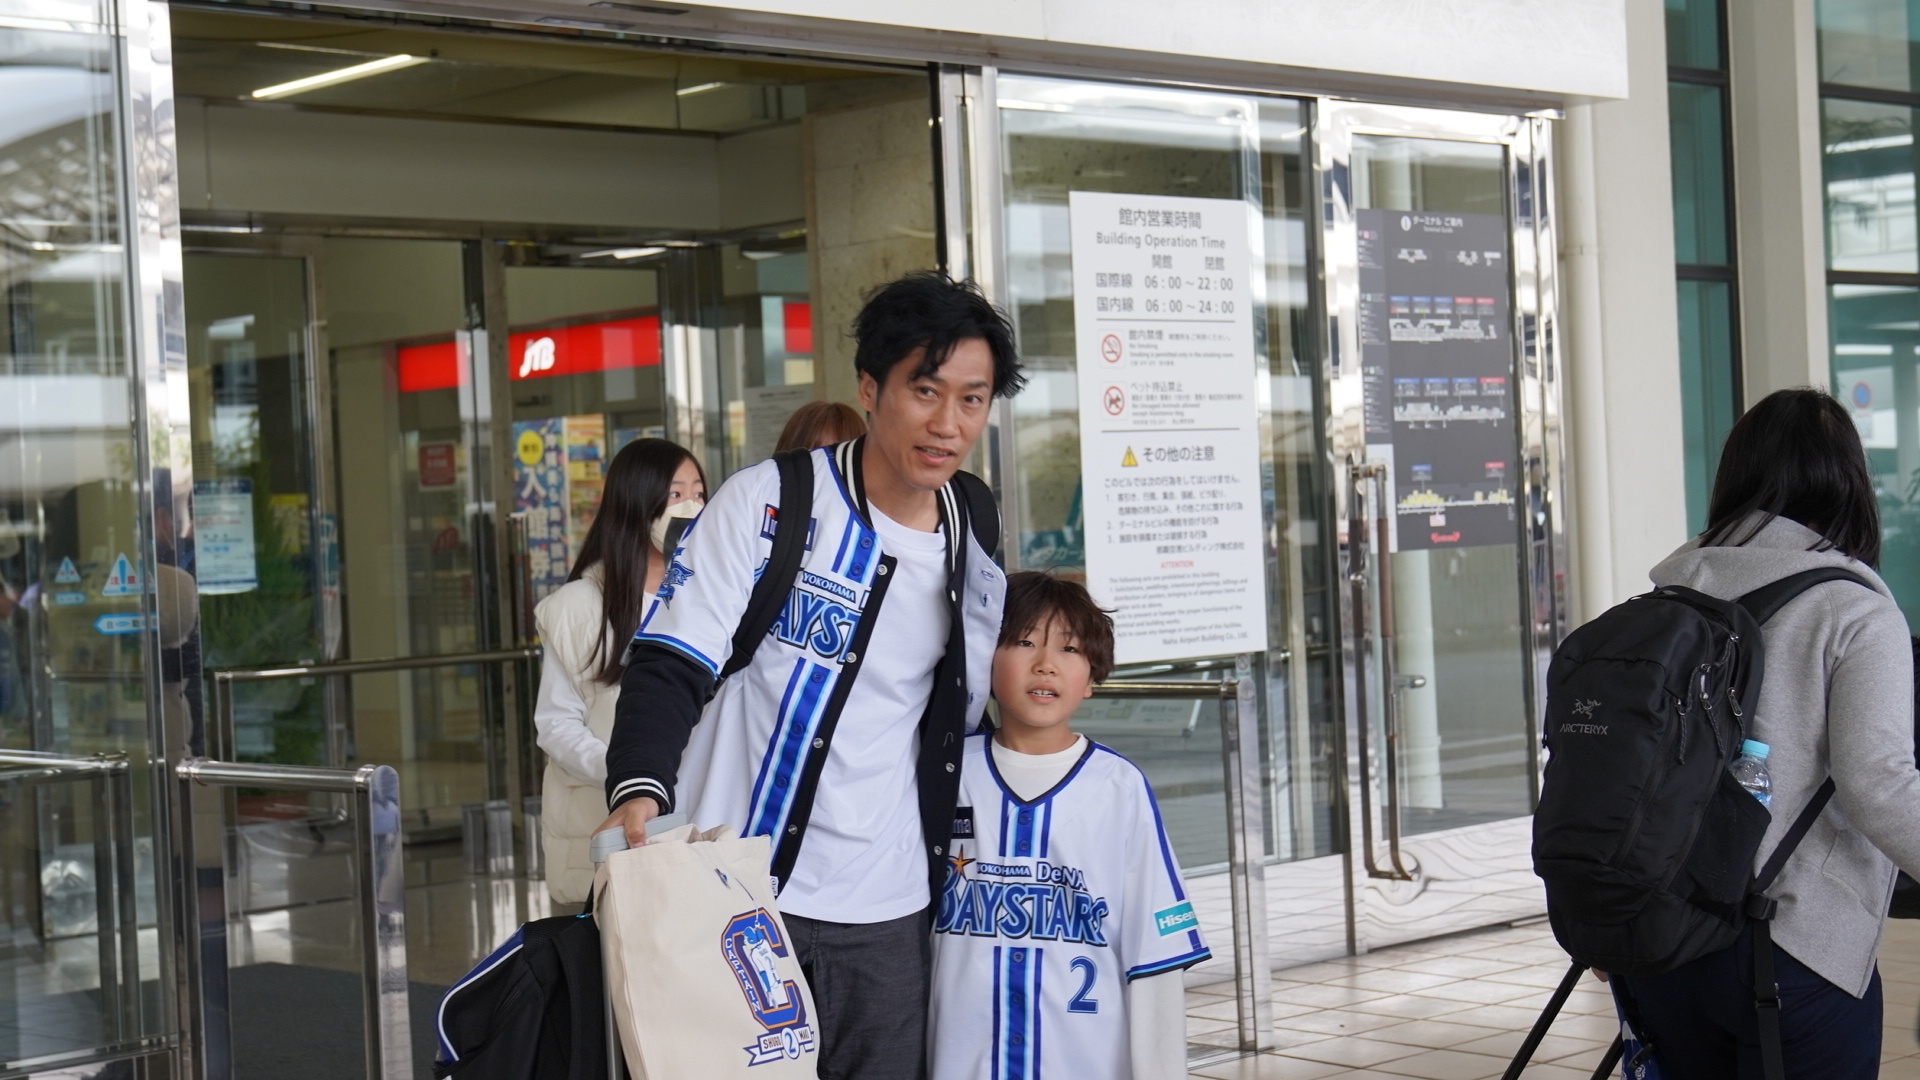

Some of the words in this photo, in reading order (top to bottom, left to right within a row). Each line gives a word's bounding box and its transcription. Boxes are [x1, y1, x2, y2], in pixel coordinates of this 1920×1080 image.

[1119, 208, 1202, 229] 館内営業時間
[1413, 215, 1442, 225] ターミナル
[1097, 232, 1141, 248] Building
[1145, 234, 1197, 249] Operation
[1201, 237, 1225, 249] Time
[1152, 255, 1173, 269] 開館
[1205, 256, 1225, 271] 閉館
[1096, 273, 1133, 288] 国際線
[1097, 297, 1134, 313] 国内線
[519, 337, 556, 378] JTB
[1143, 446, 1215, 462] その他の注意
[802, 571, 857, 604] YOKOHAMA
[1036, 861, 1089, 891] DeNA
[725, 938, 761, 1012] CAPTAIN
[1067, 956, 1098, 1014] 2
[784, 1032, 797, 1054] 2
